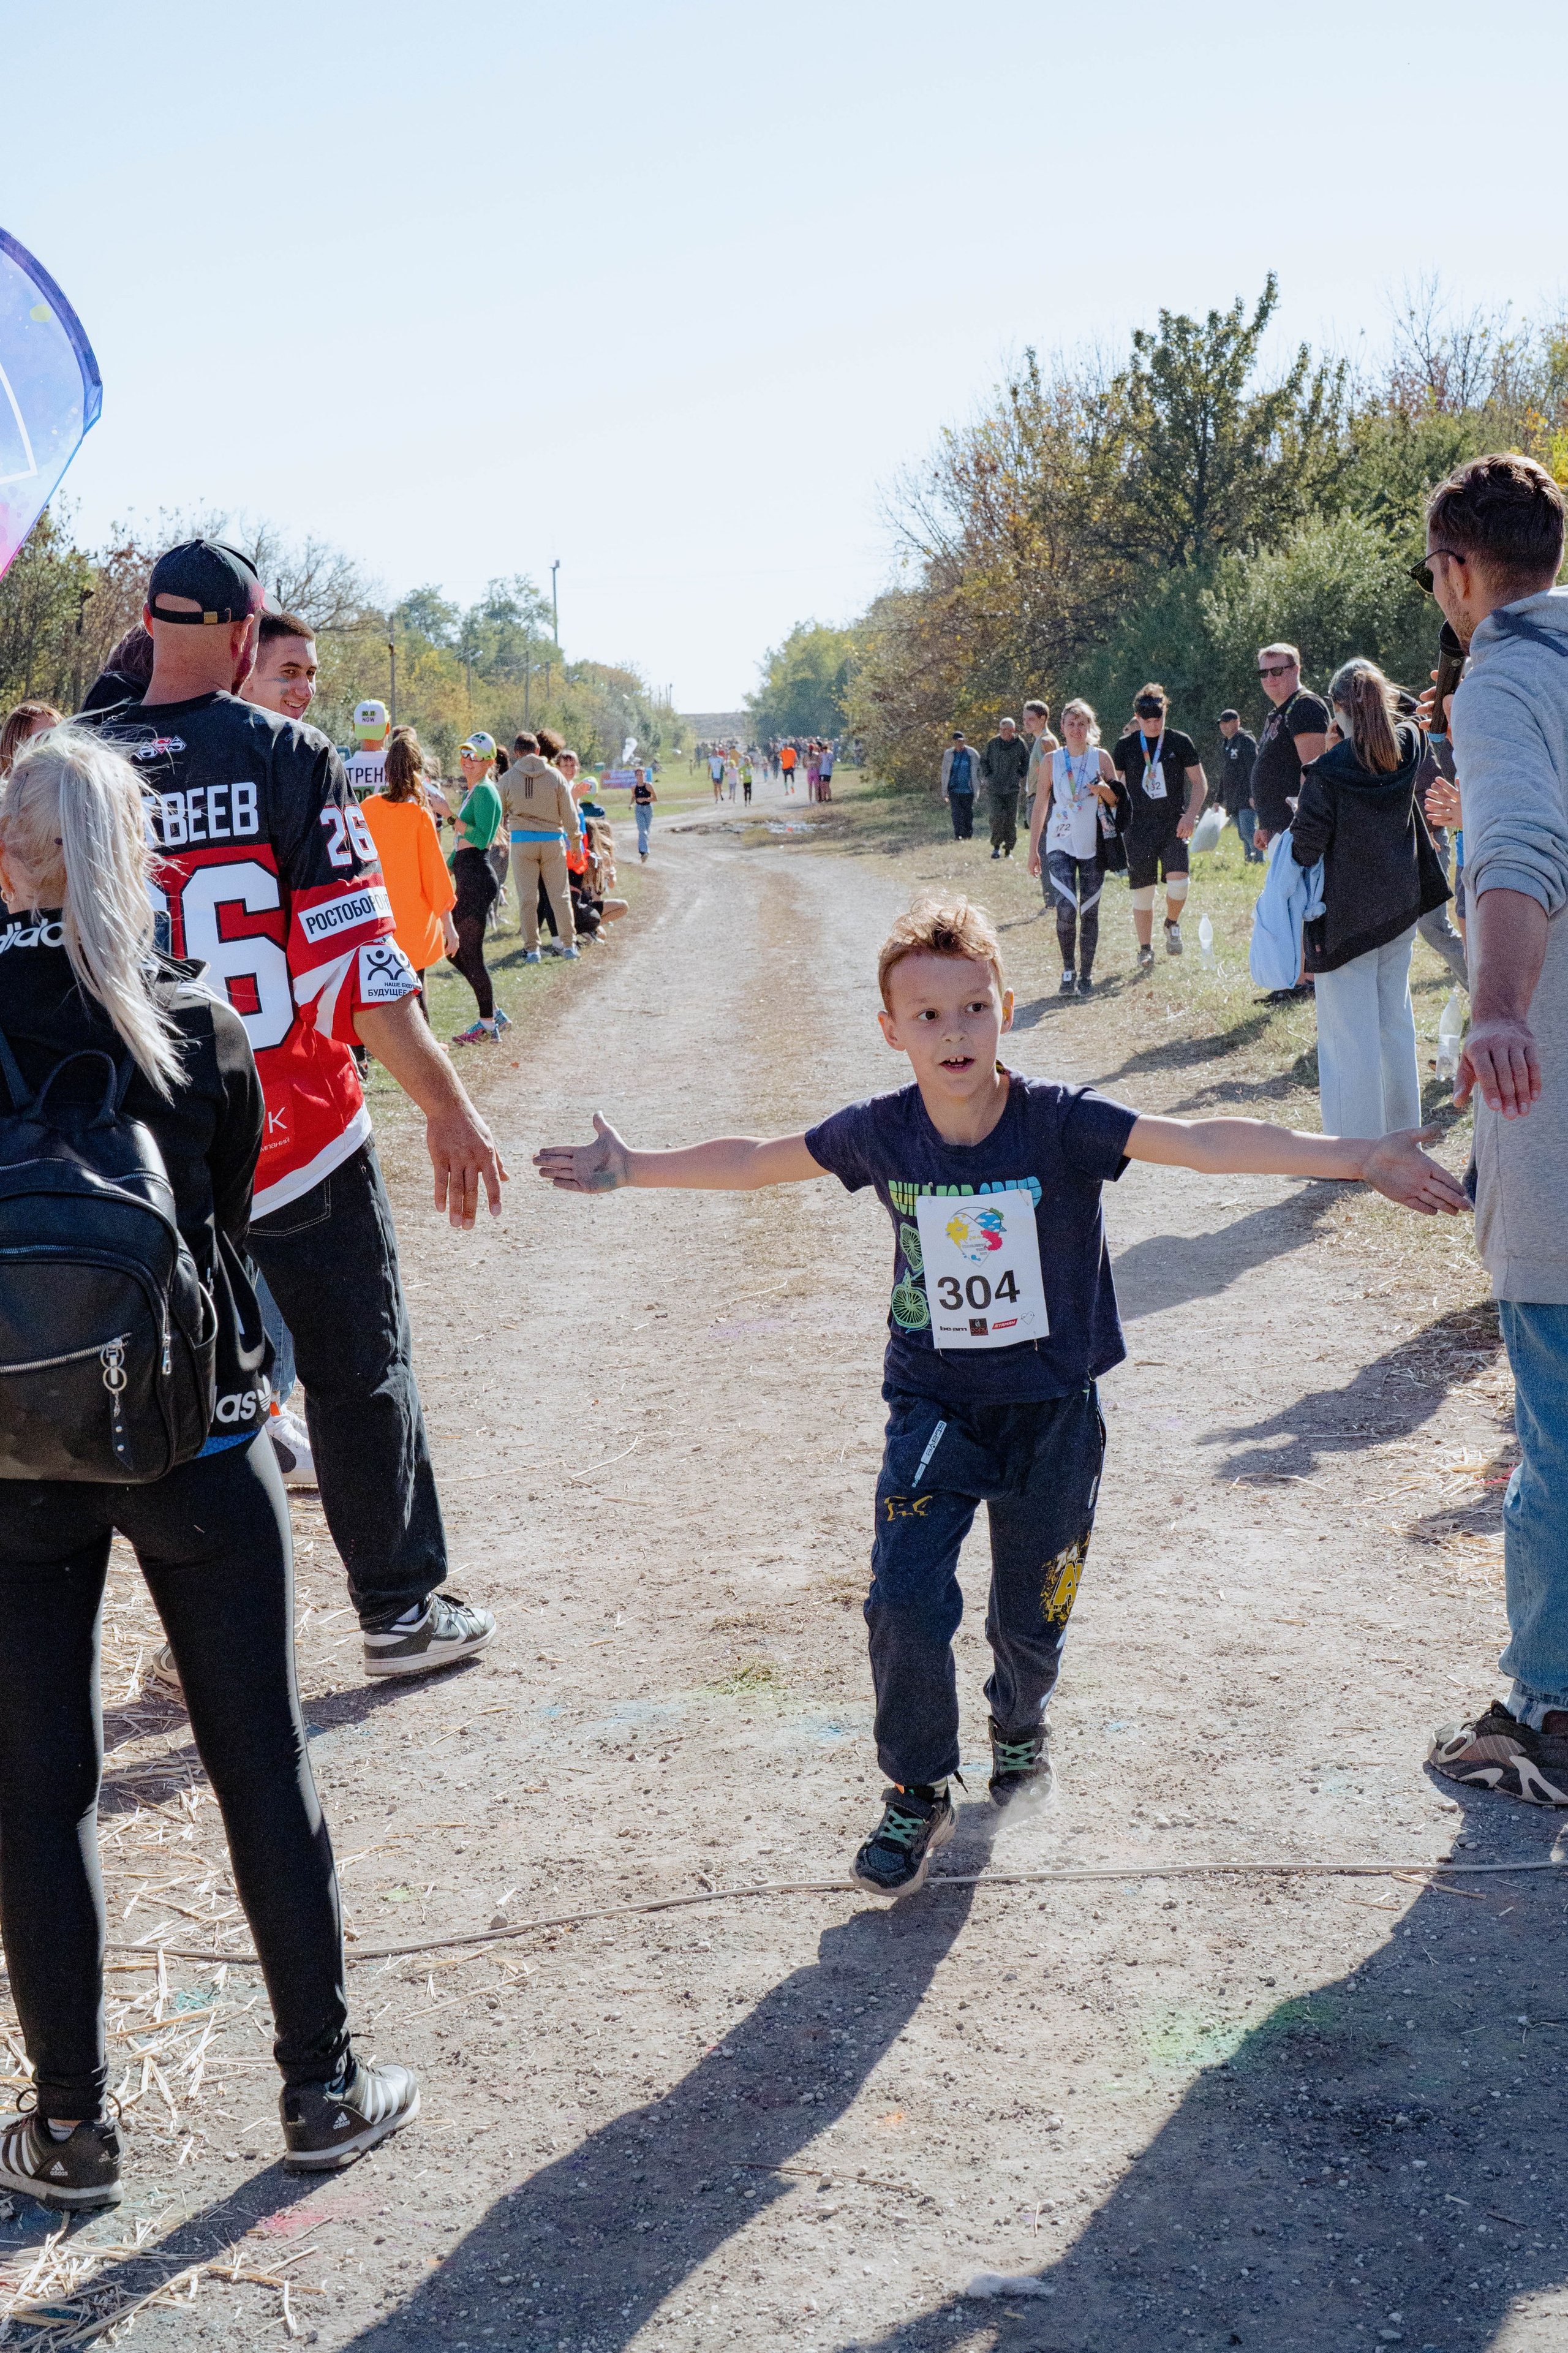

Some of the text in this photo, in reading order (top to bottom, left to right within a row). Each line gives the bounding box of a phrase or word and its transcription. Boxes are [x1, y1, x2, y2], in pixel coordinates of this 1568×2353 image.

[346, 767, 388, 783] ТРЕН
[319, 804, 379, 868] 26
[1056, 823, 1071, 833] 172
[937, 1270, 1020, 1310] 304
[210, 1386, 257, 1423] as
[333, 2120, 351, 2129] adidas
